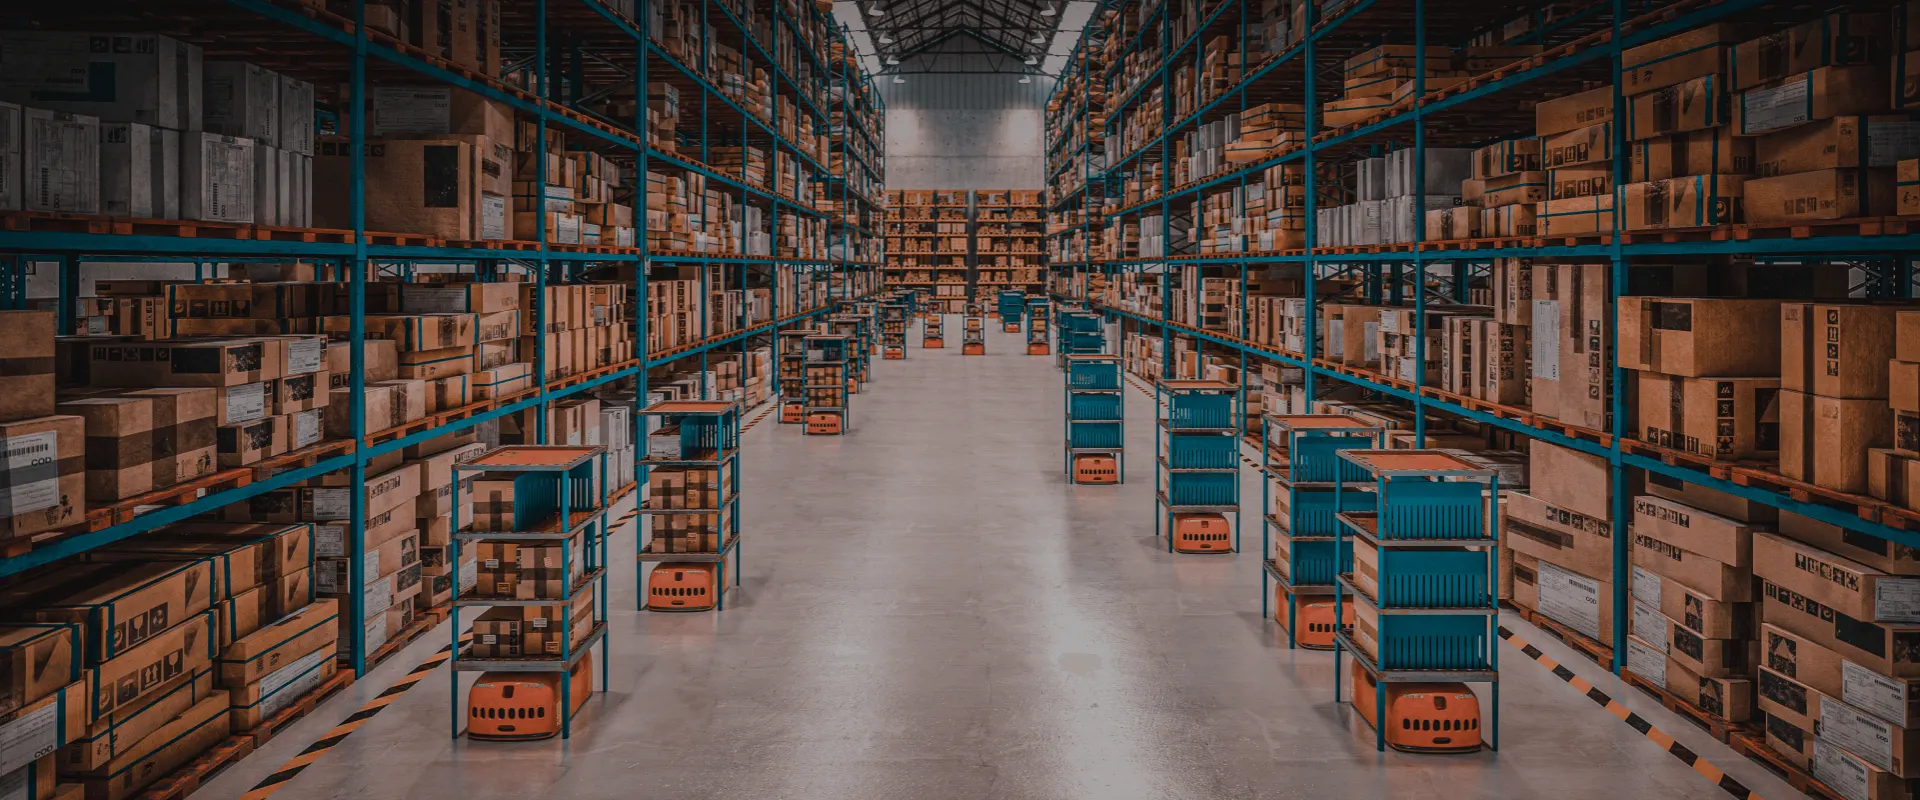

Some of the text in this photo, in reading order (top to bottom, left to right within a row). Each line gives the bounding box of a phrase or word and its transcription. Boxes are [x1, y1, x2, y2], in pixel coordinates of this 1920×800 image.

[31, 456, 52, 467] COD
[1585, 596, 1597, 605] COD
[34, 744, 53, 758] COD
